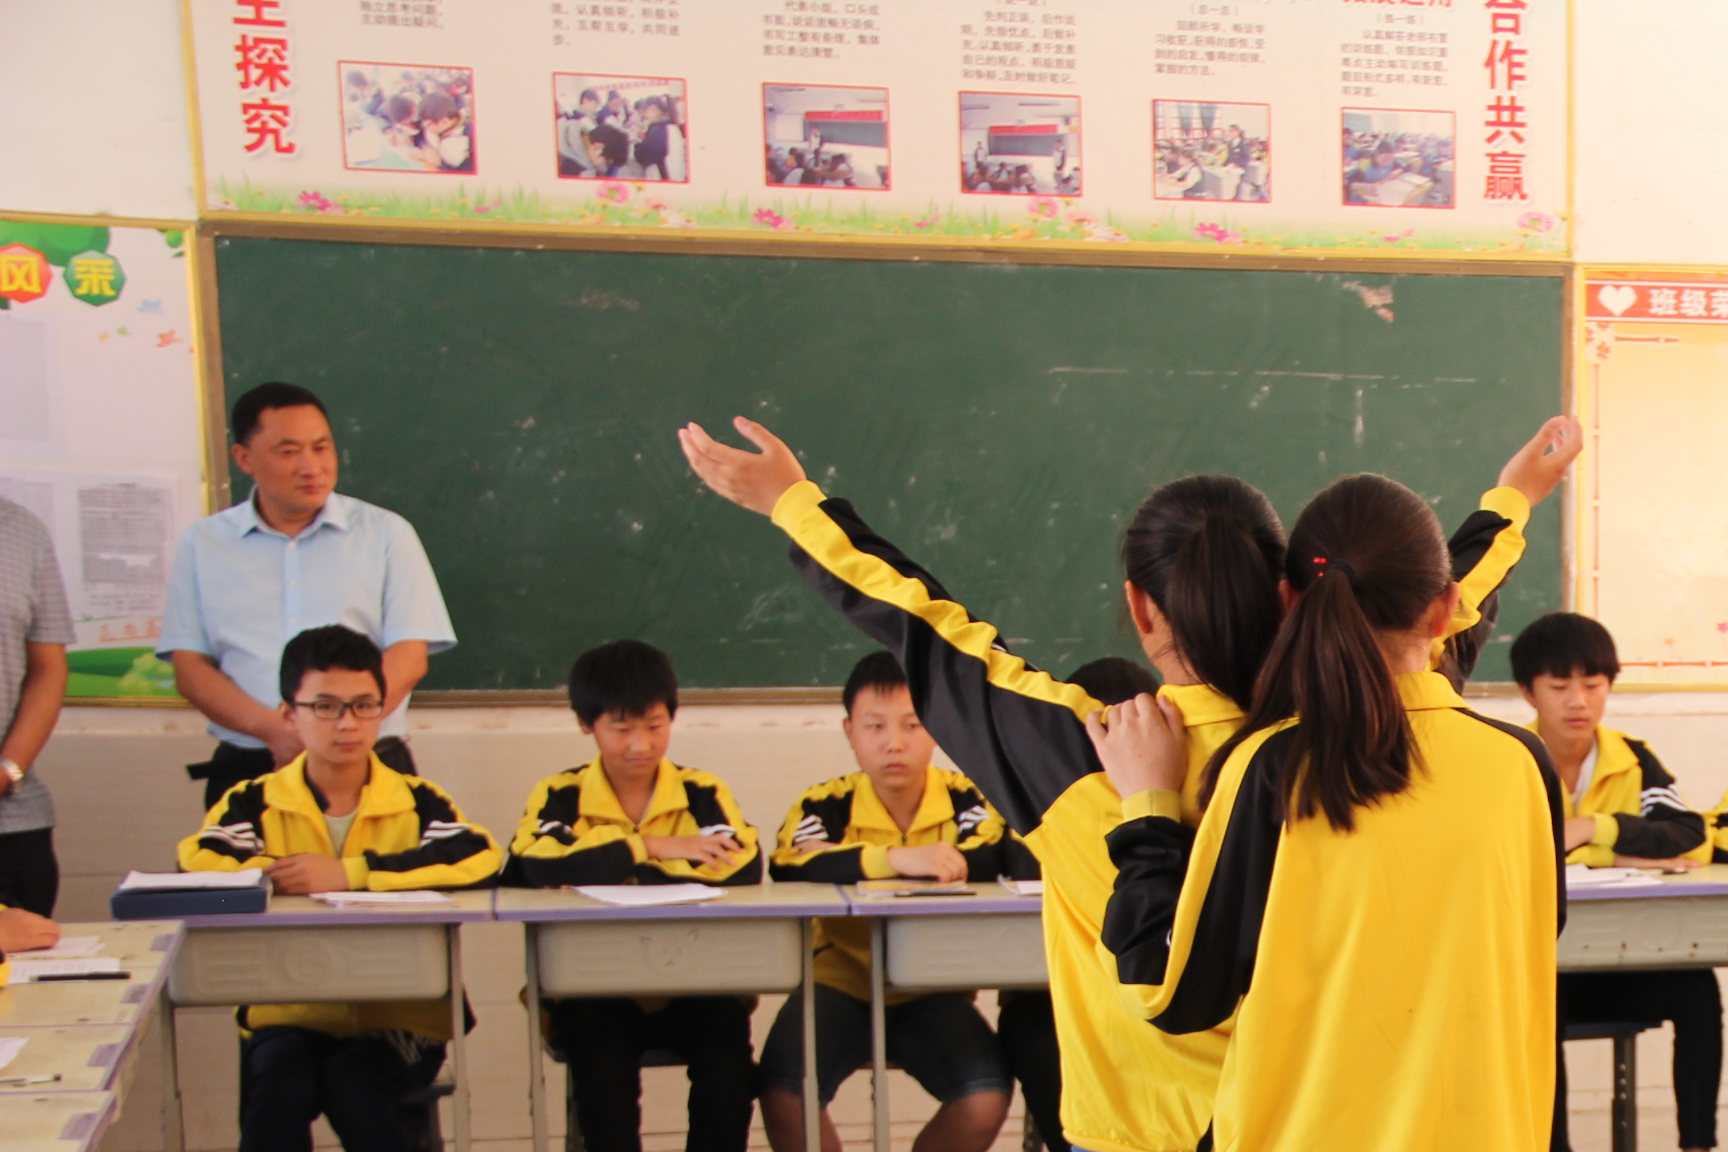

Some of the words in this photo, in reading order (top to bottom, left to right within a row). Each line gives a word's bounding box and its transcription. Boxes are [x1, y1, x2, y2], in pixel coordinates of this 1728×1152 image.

[1483, 0, 1528, 200] 合作共赢
[0, 253, 117, 297] 风采
